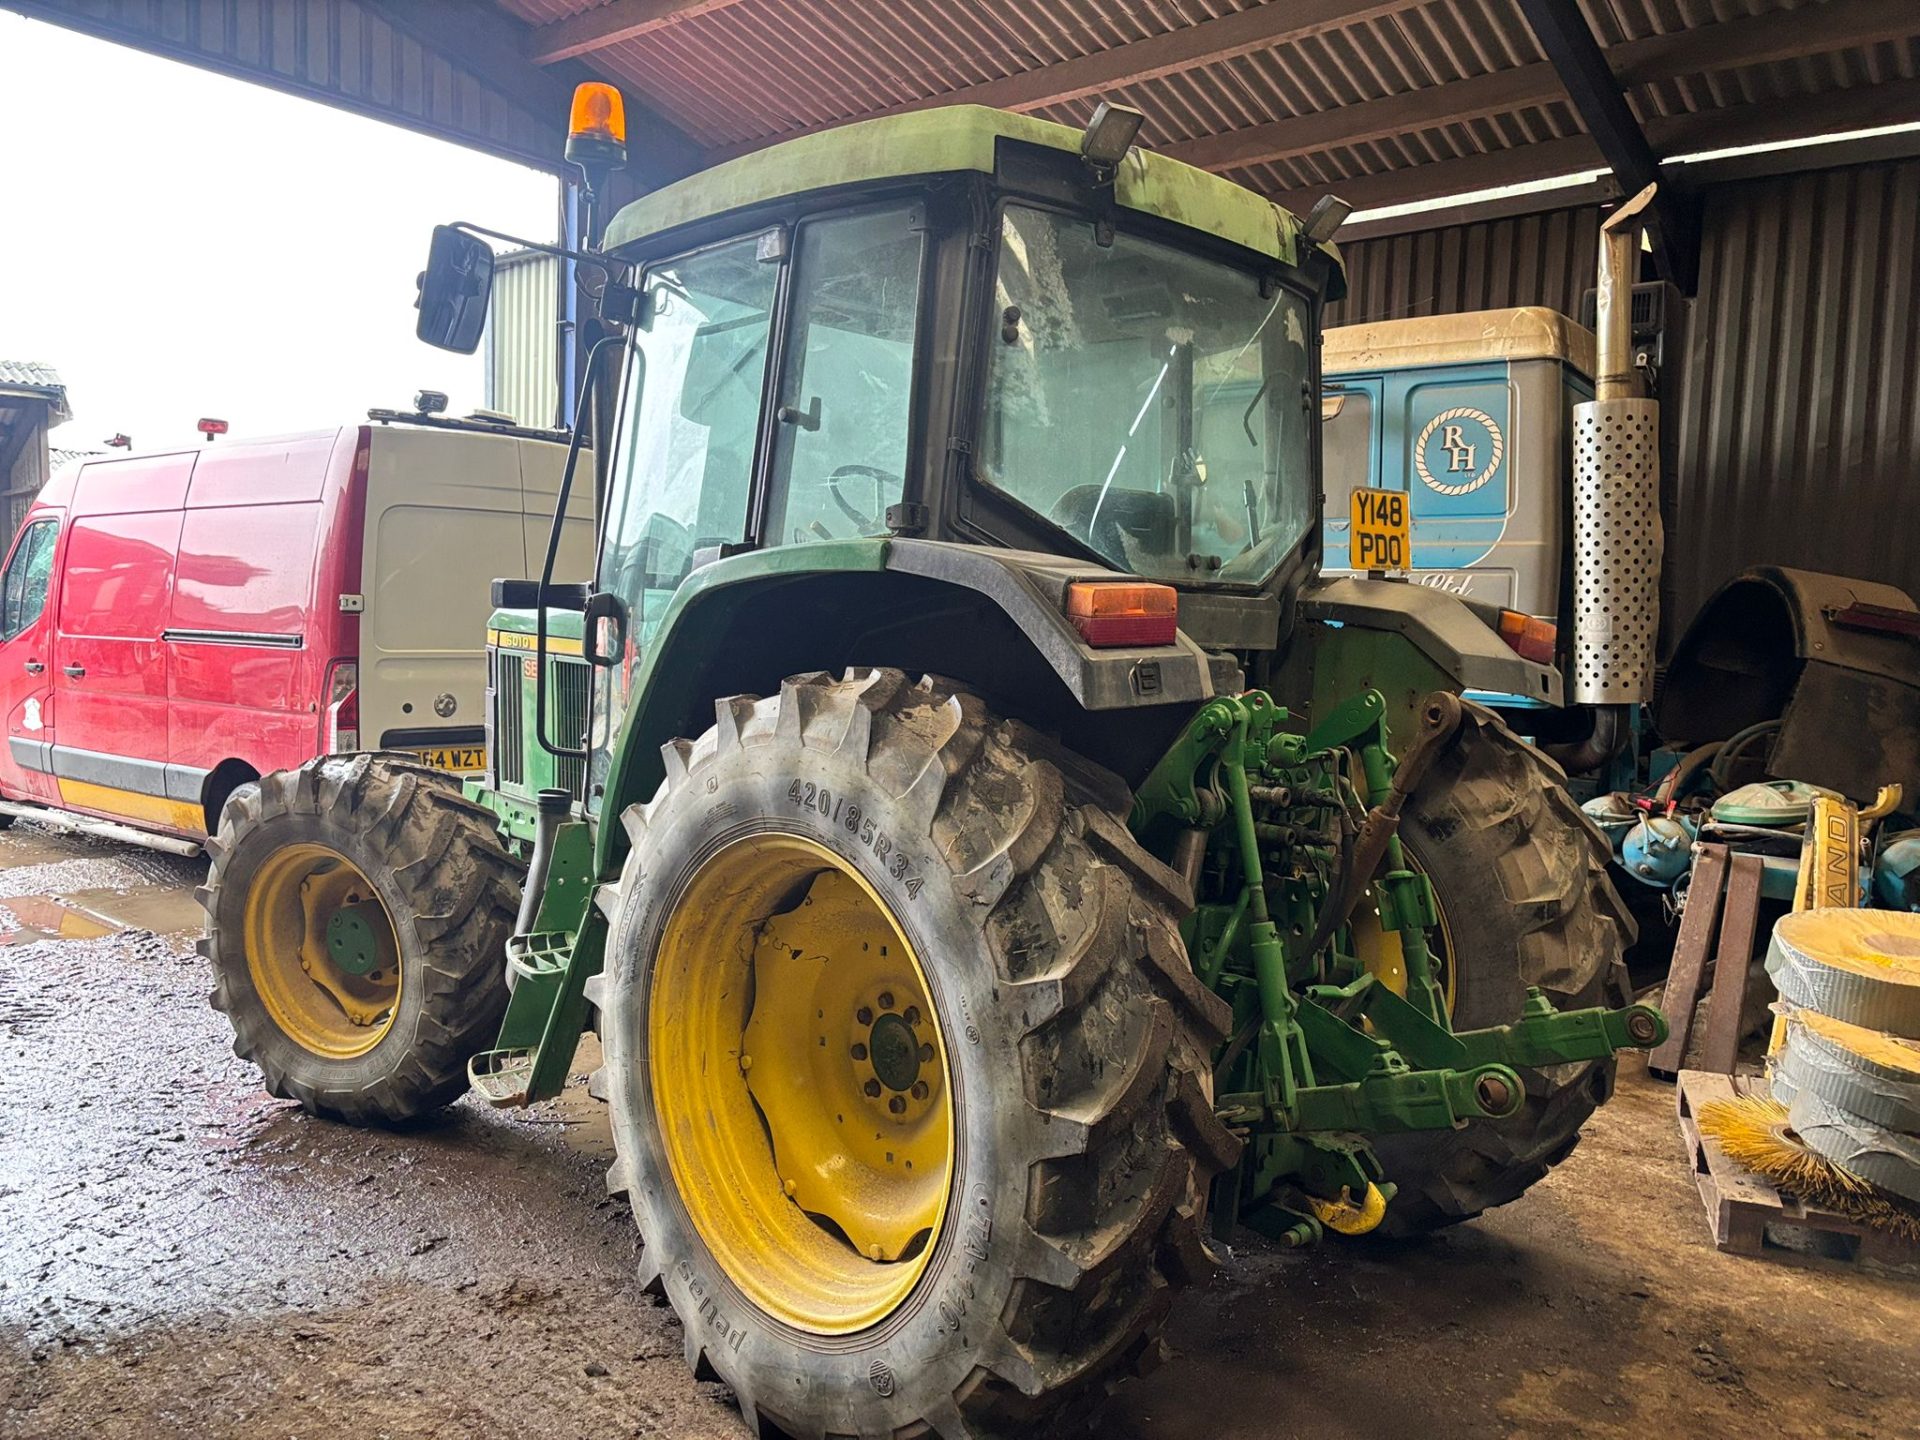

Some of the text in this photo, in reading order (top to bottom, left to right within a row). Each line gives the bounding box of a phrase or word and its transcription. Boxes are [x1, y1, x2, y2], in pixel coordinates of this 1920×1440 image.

[1357, 491, 1402, 527] Y148
[1360, 532, 1401, 566] PDO
[450, 749, 484, 768] WZT
[788, 778, 925, 901] 420/85R34
